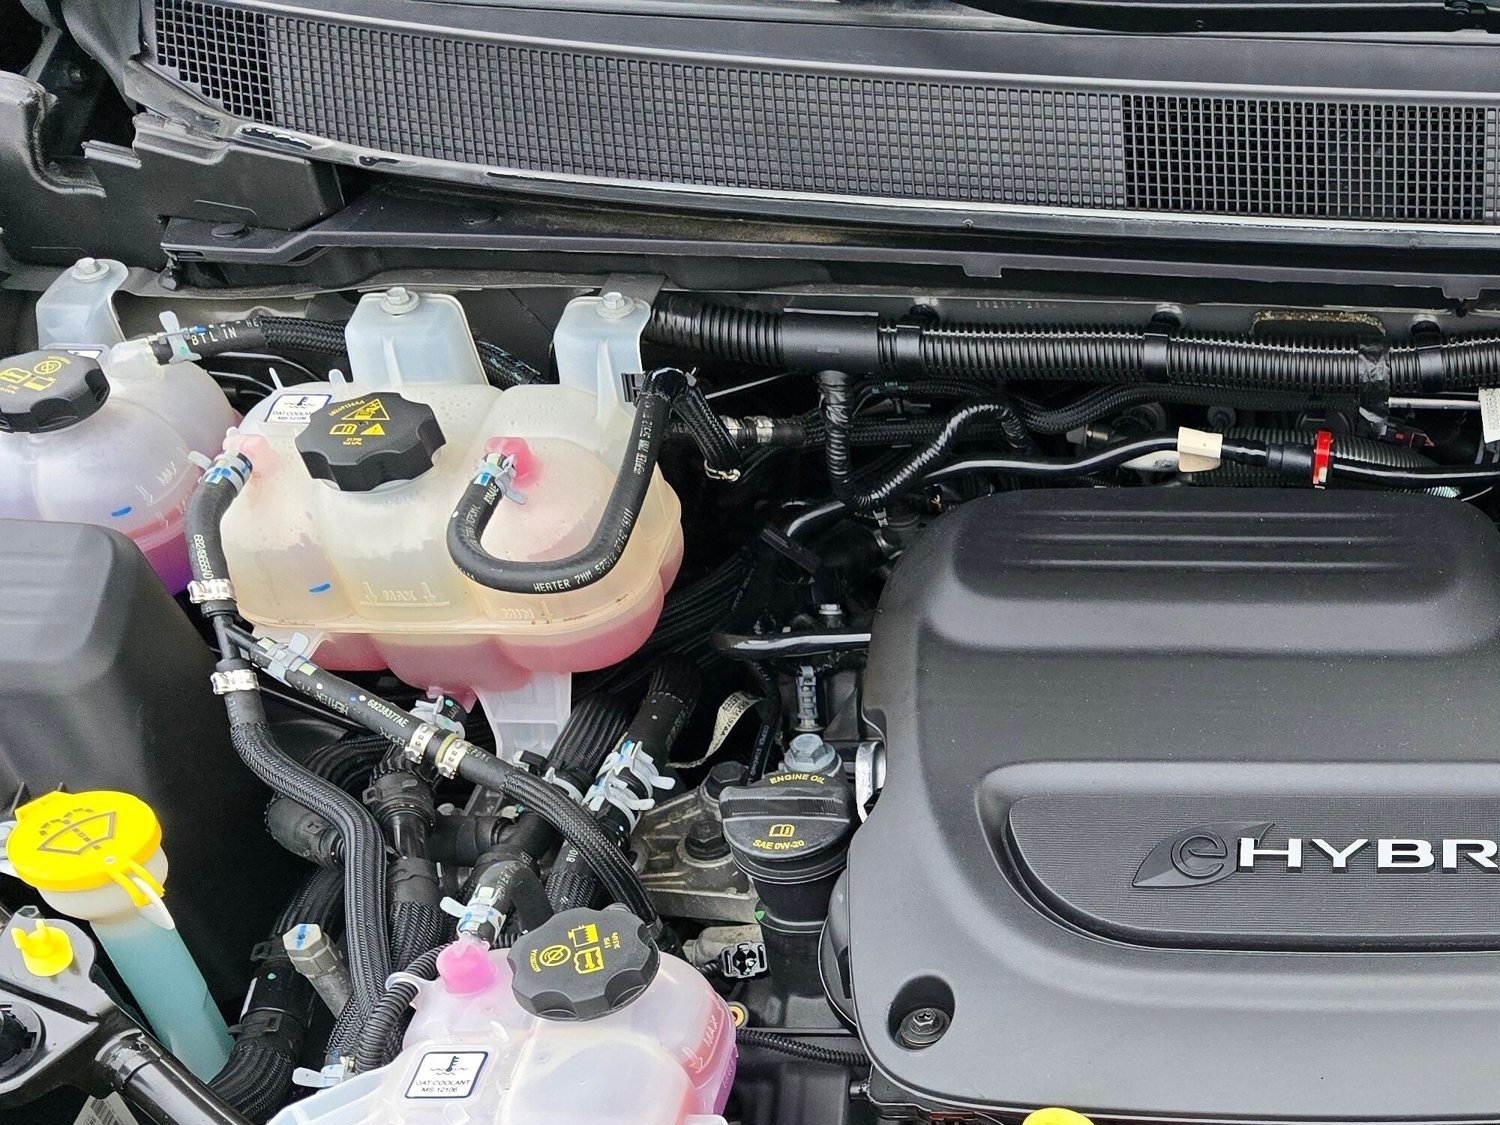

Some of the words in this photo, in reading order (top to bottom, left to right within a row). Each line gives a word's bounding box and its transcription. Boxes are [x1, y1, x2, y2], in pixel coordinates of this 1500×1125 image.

[191, 331, 219, 346] BTL
[222, 327, 237, 340] IN
[533, 577, 571, 592] HEATER
[574, 571, 593, 585] 7MM
[366, 698, 409, 728] 68238377AE
[769, 774, 809, 784] ENGINE
[810, 775, 826, 784] OIL
[752, 839, 774, 850] SAE
[774, 839, 805, 850] 0W-20
